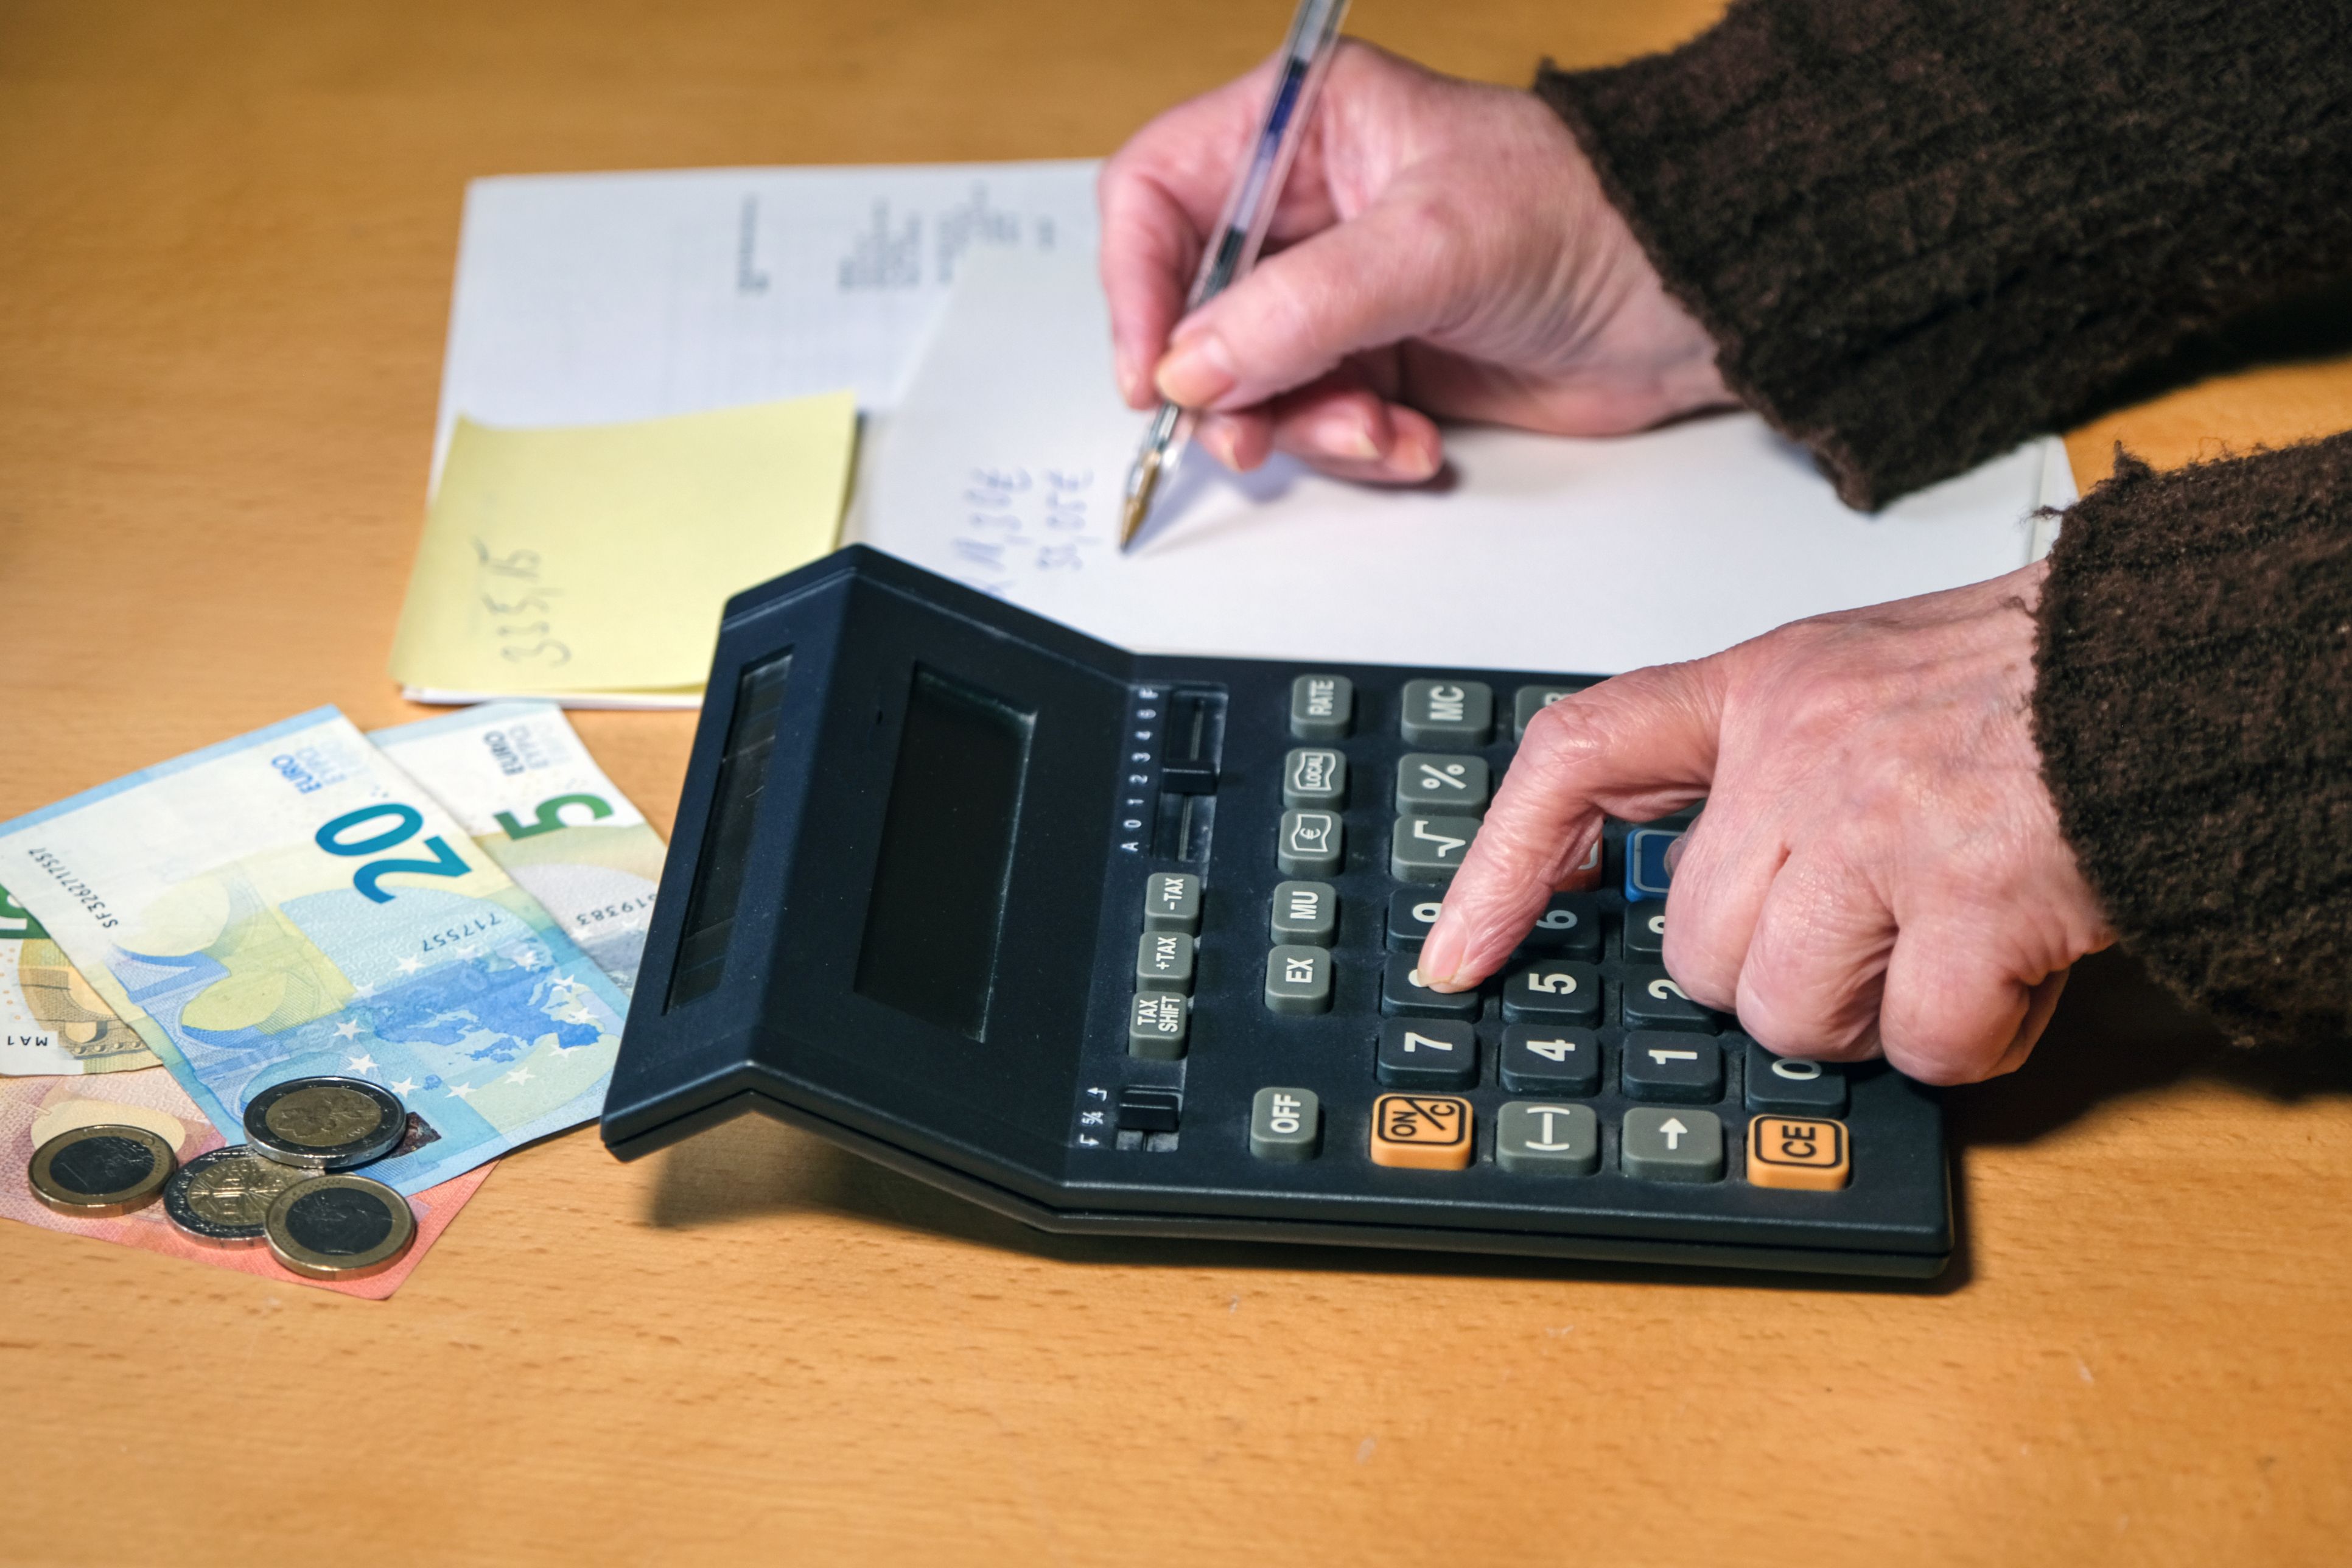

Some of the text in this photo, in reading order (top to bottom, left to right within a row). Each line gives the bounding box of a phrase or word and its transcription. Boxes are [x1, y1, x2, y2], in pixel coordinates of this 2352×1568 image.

[1139, 688, 1158, 699] F
[1309, 679, 1334, 716] RATE
[1429, 685, 1465, 721] MC
[1132, 752, 1151, 762] 3
[270, 754, 323, 794] EURO
[1129, 774, 1148, 784] 2
[1306, 755, 1323, 788] LOCAL
[1420, 764, 1466, 789] %
[493, 793, 614, 841] 5
[1123, 819, 1141, 828] 0
[315, 803, 472, 904] 20
[1121, 841, 1139, 852] A
[1290, 891, 1319, 920] MU
[1536, 909, 1578, 929] 6
[422, 913, 501, 952] 717557
[1156, 936, 1177, 970] +TAX
[1286, 957, 1314, 983] EX
[1528, 973, 1577, 995] 5
[1137, 999, 1158, 1026] TAX
[1158, 996, 1180, 1032] SHIFT
[7, 1035, 48, 1046] MA1
[1404, 1032, 1453, 1052] 7
[1527, 1038, 1575, 1062] 4
[1648, 1048, 1698, 1065] 1
[1772, 1059, 1822, 1080] 0
[1271, 1094, 1301, 1133] OFF
[1781, 1126, 1816, 1158] CE
